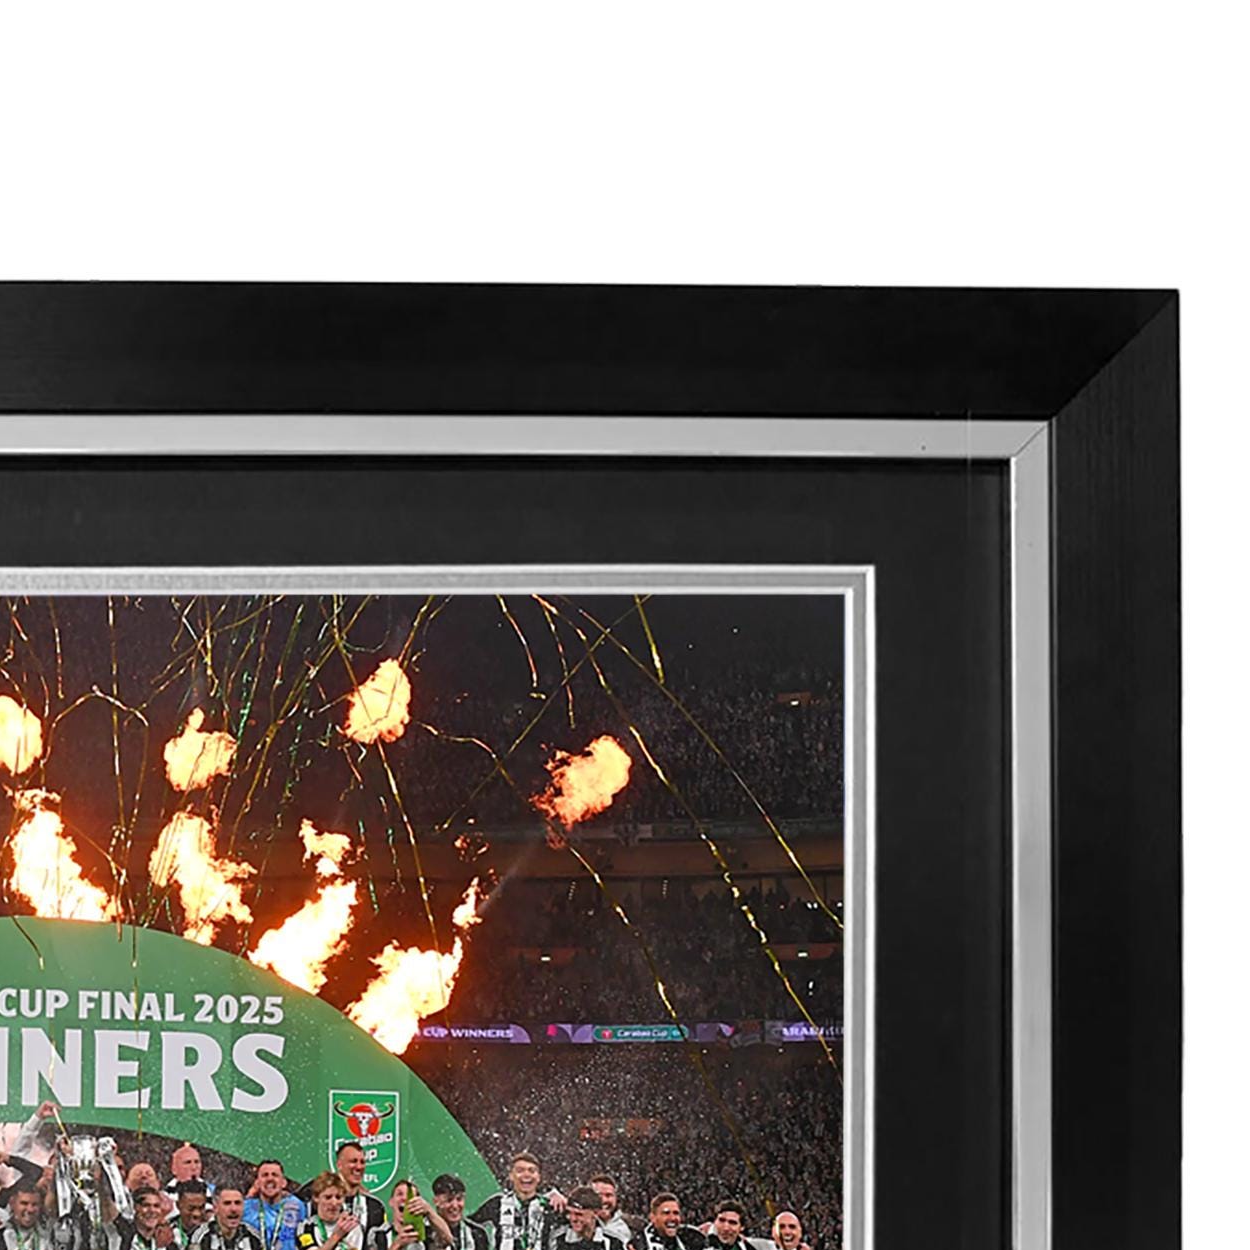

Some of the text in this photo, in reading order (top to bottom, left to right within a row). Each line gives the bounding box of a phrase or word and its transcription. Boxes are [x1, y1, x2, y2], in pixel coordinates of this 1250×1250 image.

[78, 990, 185, 1022] FINAL
[194, 993, 284, 1025] 2025
[422, 1027, 514, 1038] CUP WINNERS
